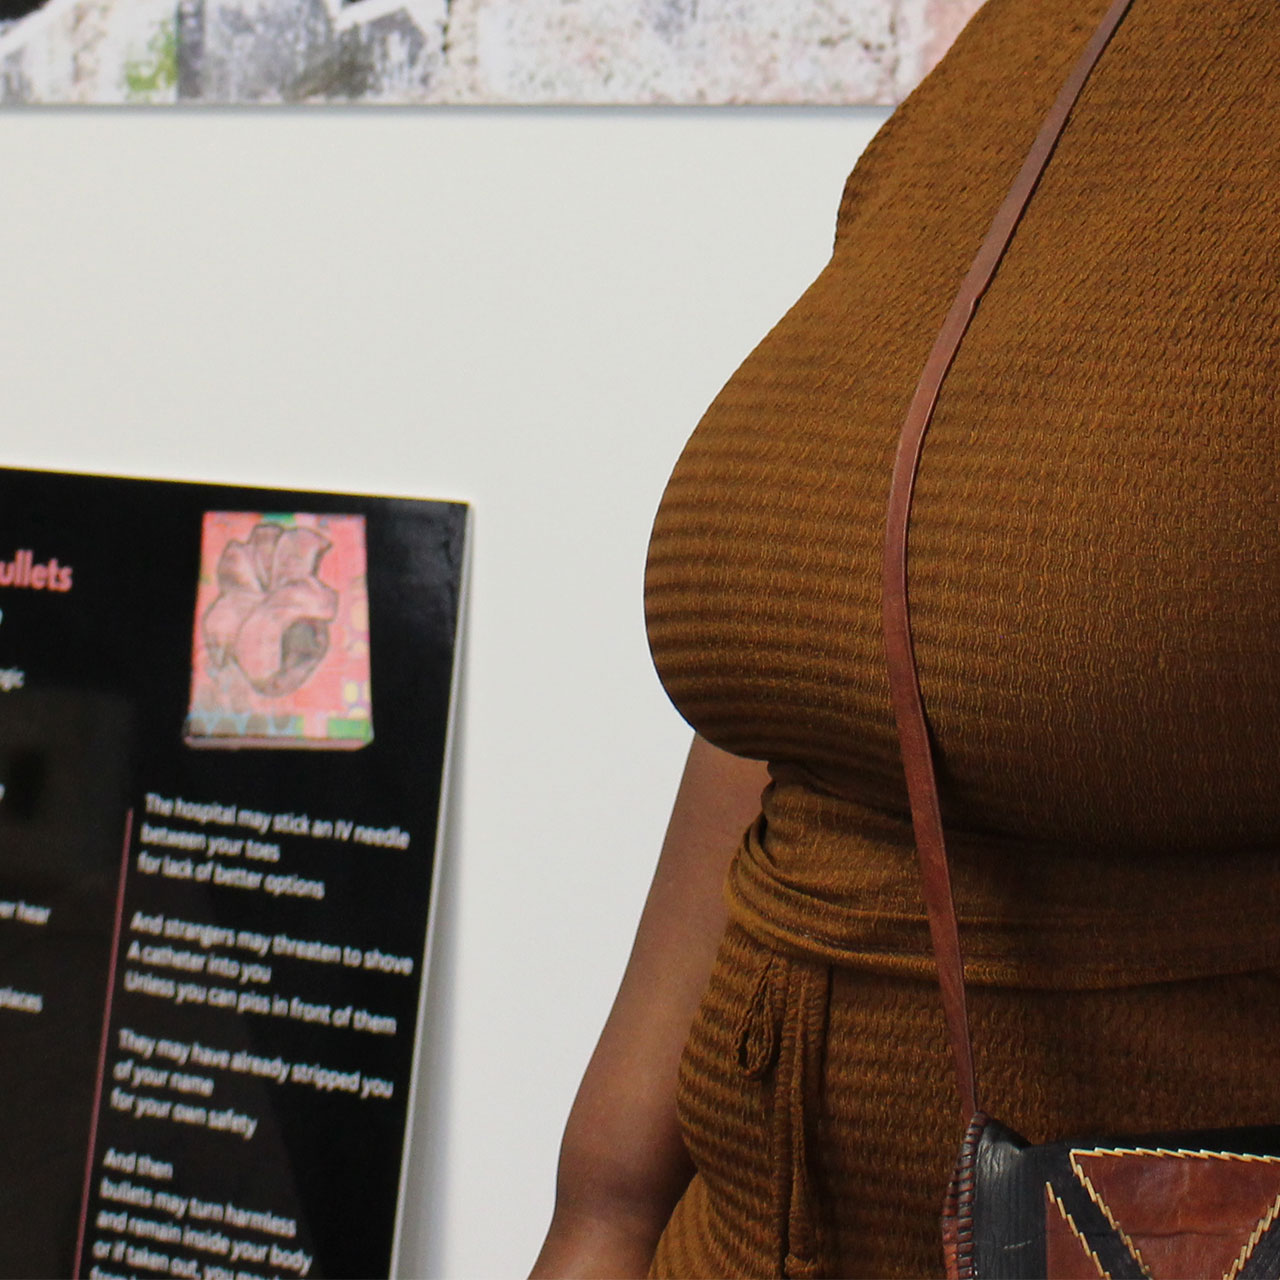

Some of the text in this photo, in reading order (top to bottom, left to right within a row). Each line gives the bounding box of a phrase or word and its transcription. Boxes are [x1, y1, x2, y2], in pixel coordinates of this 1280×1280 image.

[140, 823, 281, 862] between your toes
[145, 792, 411, 850] The hospital may stick an IV needle
[138, 851, 325, 900] for lack of better options
[127, 940, 272, 985] A catheter into you
[130, 911, 414, 976] And strangers may threaten to shove
[124, 971, 398, 1035] Unless you can piss in front of them
[113, 1059, 214, 1098] of your name
[119, 1028, 394, 1099] They may have already stripped you
[110, 1087, 258, 1140] for your own safety
[103, 1147, 173, 1180] And then
[99, 1177, 297, 1238] bullets may turn harmless
[93, 1240, 112, 1259] or
[112, 1240, 126, 1262] if
[126, 1246, 169, 1271] taken
[170, 1257, 202, 1280] out,
[96, 1210, 313, 1277] and remain inside your body
